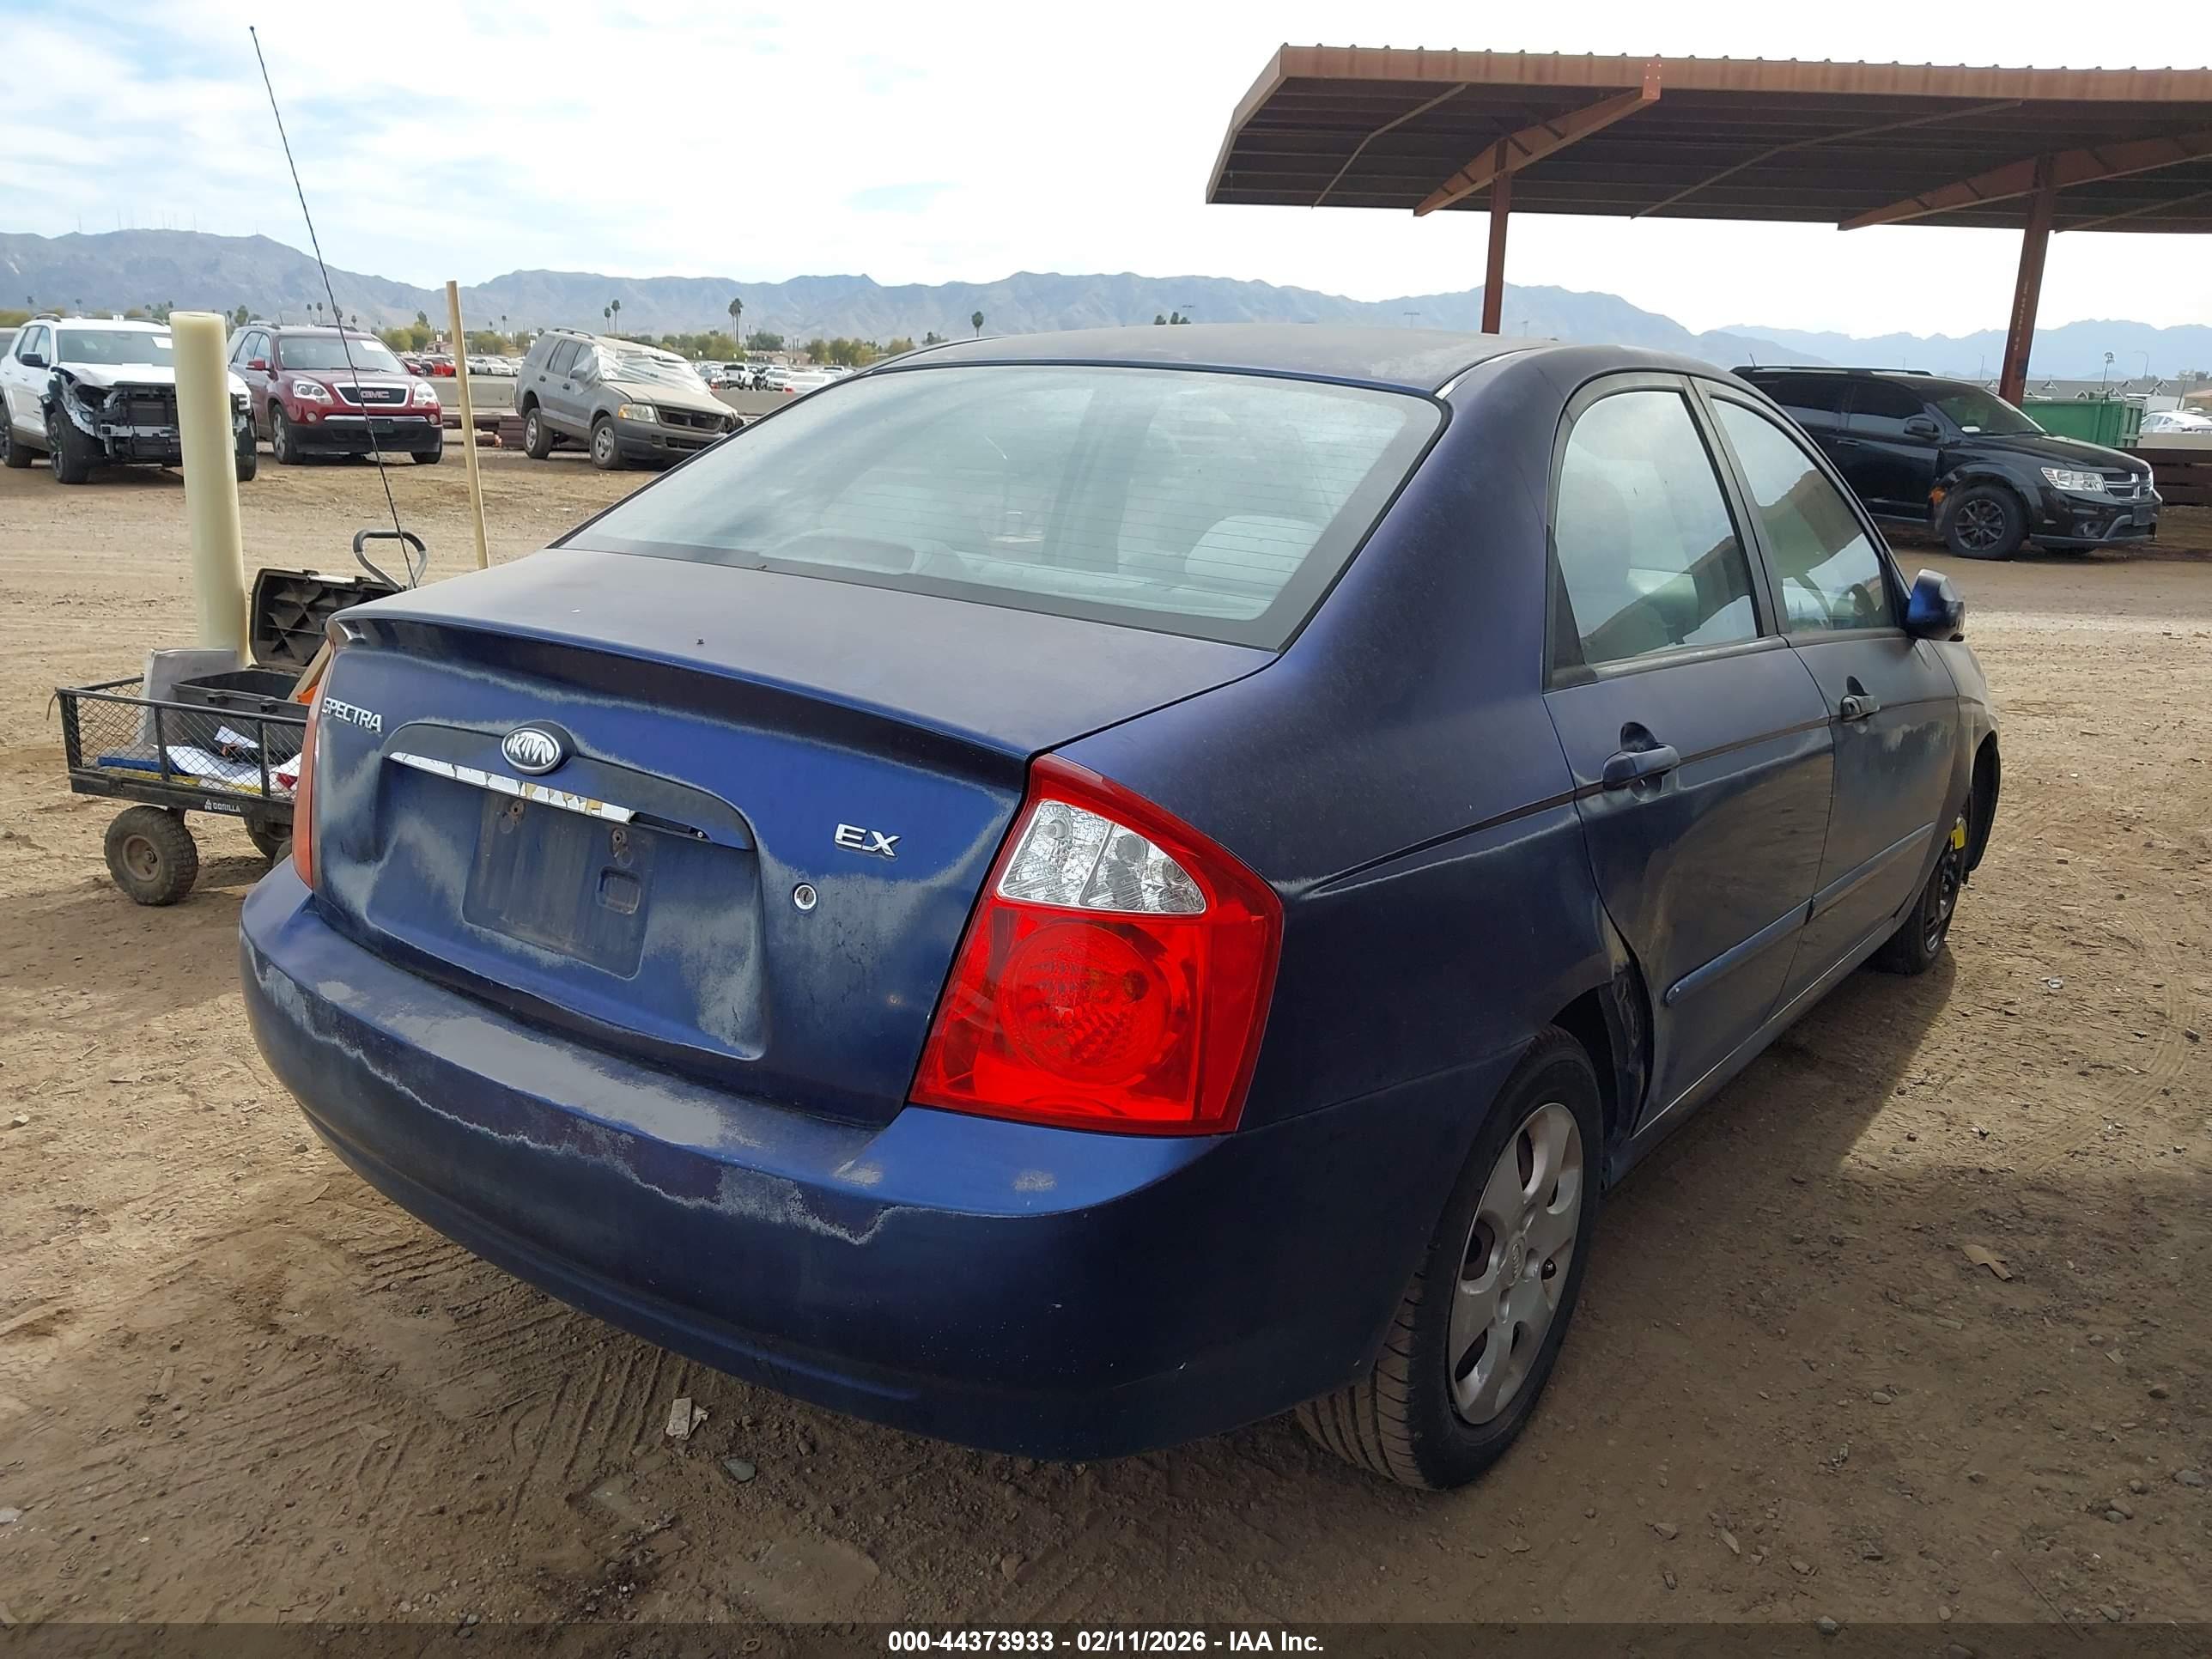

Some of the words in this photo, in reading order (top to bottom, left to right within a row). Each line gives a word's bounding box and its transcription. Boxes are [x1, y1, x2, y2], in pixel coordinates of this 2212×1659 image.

[361, 391, 390, 399] GMC
[321, 697, 383, 732] SPECTRA
[212, 802, 241, 813] GORILLA
[835, 823, 901, 857] EX
